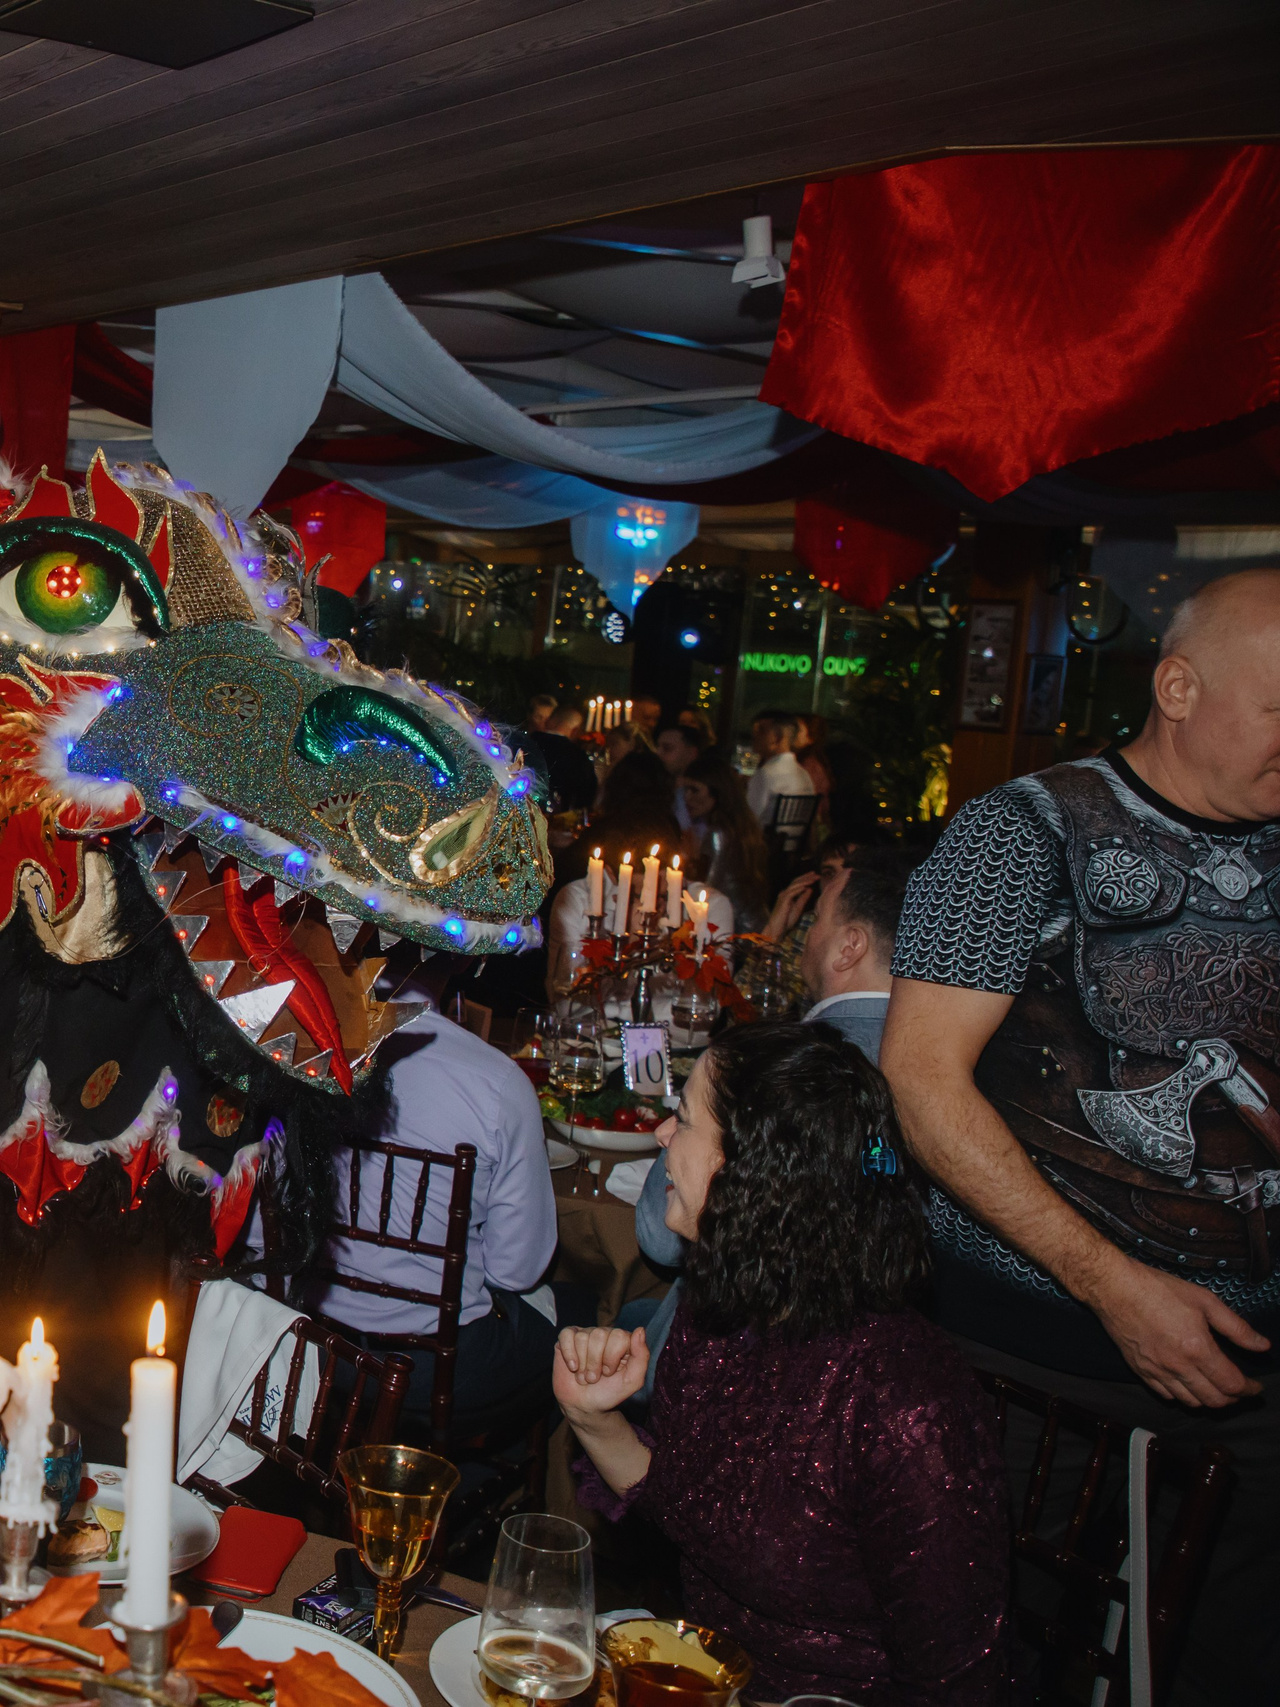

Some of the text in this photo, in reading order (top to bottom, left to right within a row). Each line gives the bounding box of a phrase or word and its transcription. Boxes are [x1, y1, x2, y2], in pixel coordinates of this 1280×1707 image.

[742, 652, 812, 674] NUKOVO
[633, 1048, 664, 1084] 10
[314, 1618, 338, 1633] KENT
